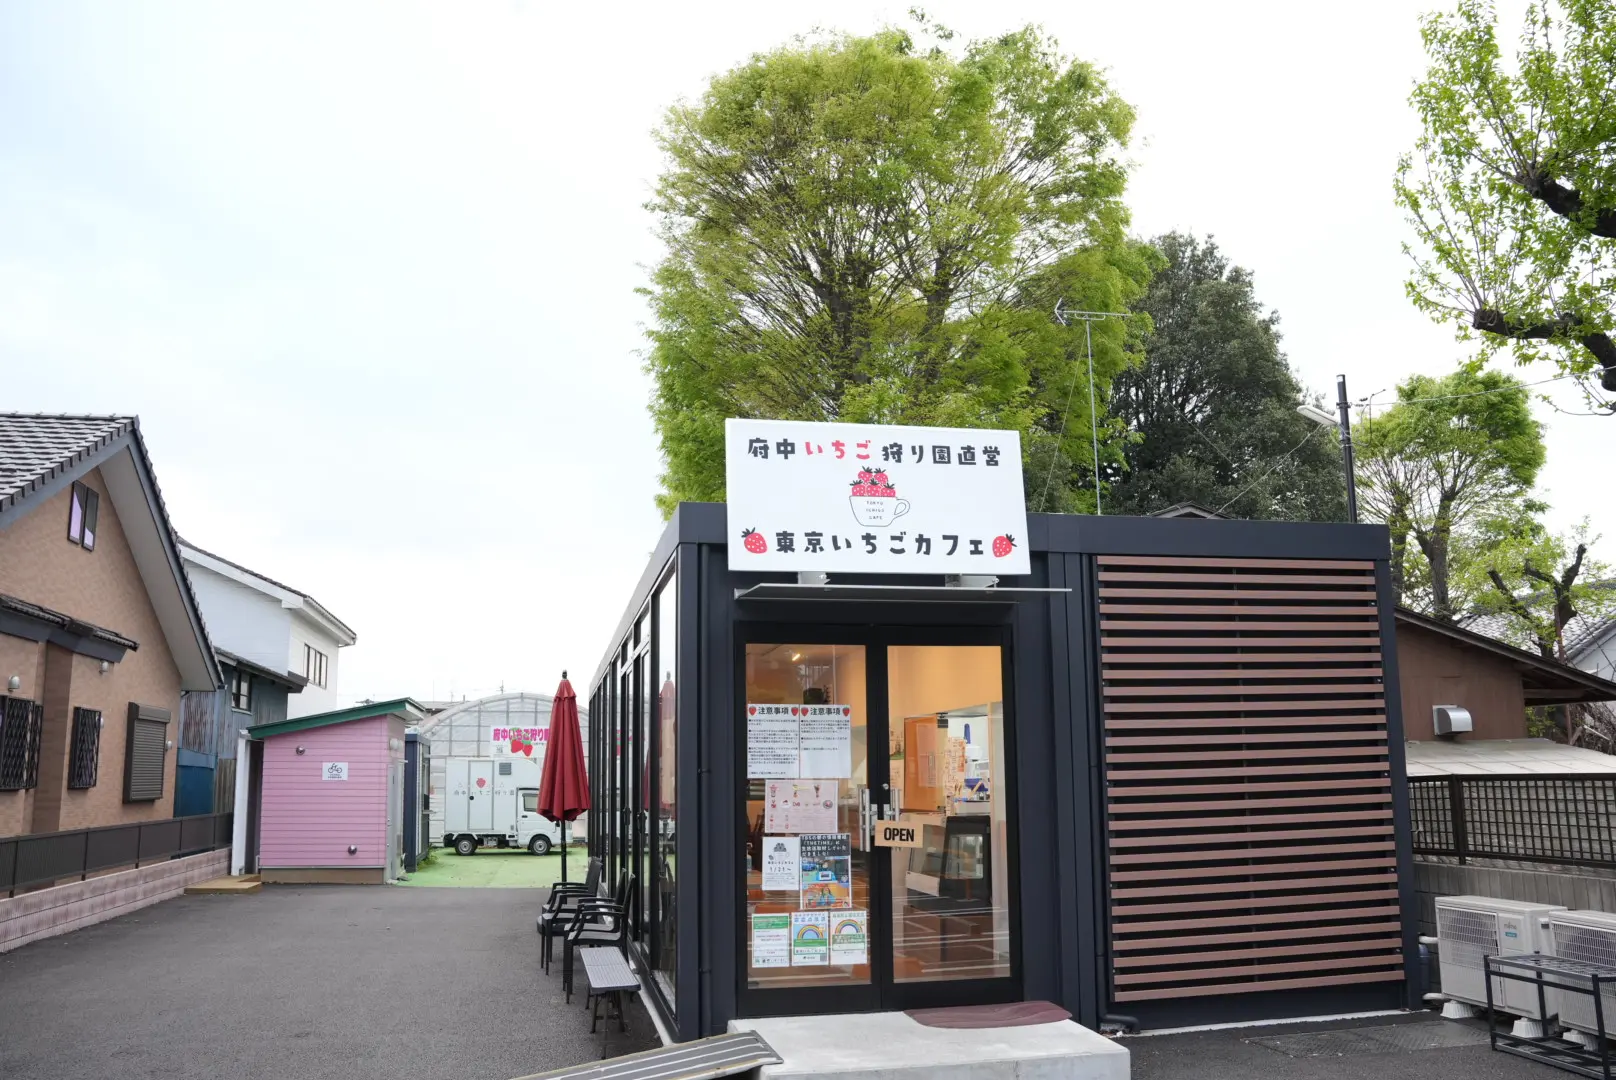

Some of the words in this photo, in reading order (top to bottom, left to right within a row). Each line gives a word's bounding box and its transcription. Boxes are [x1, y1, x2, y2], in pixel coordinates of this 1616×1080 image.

[748, 438, 1001, 467] 府中いちご狩り園直営
[775, 530, 984, 556] 東京いちごカフェ
[758, 706, 789, 715] 注意事項
[810, 707, 841, 716] 注意事項
[883, 827, 915, 842] OPEN
